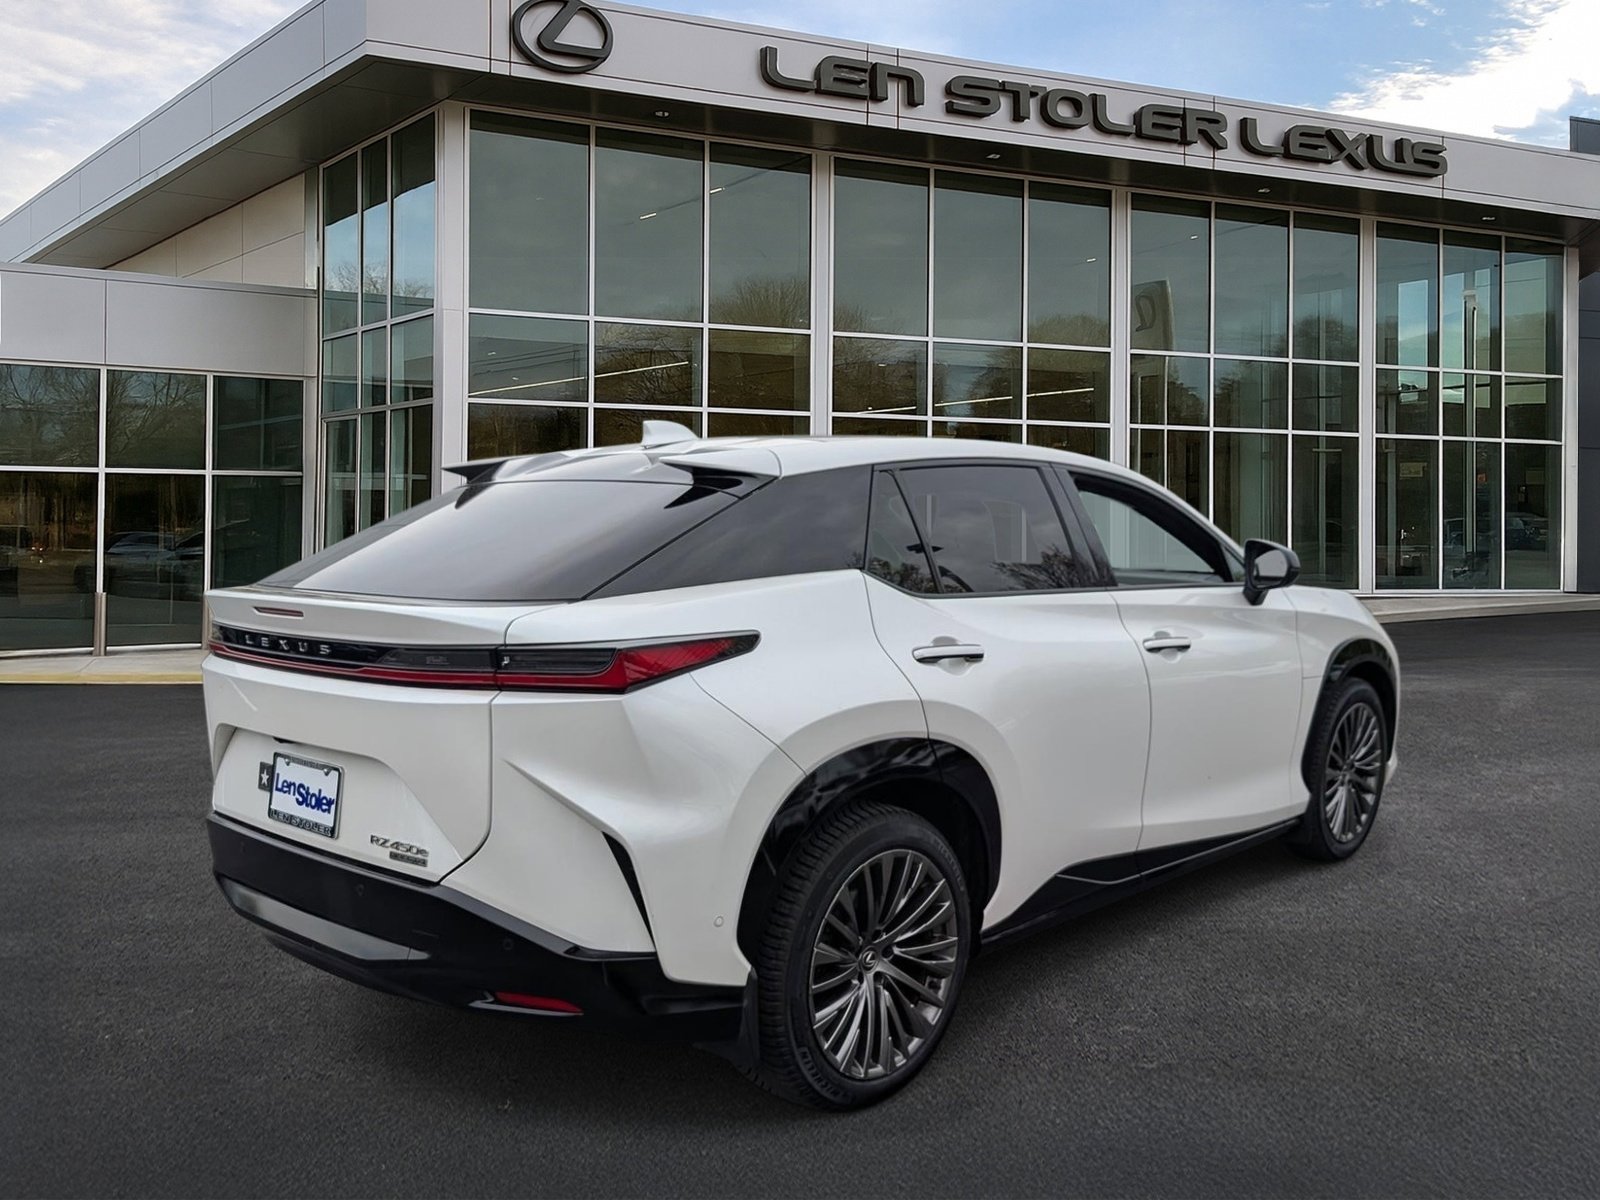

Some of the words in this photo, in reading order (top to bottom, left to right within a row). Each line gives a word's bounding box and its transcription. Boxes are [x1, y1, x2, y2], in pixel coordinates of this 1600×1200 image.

[760, 45, 925, 107] LEN
[944, 75, 1229, 151] STOLER
[1239, 117, 1449, 178] LEXUS
[244, 634, 333, 655] LEXUS
